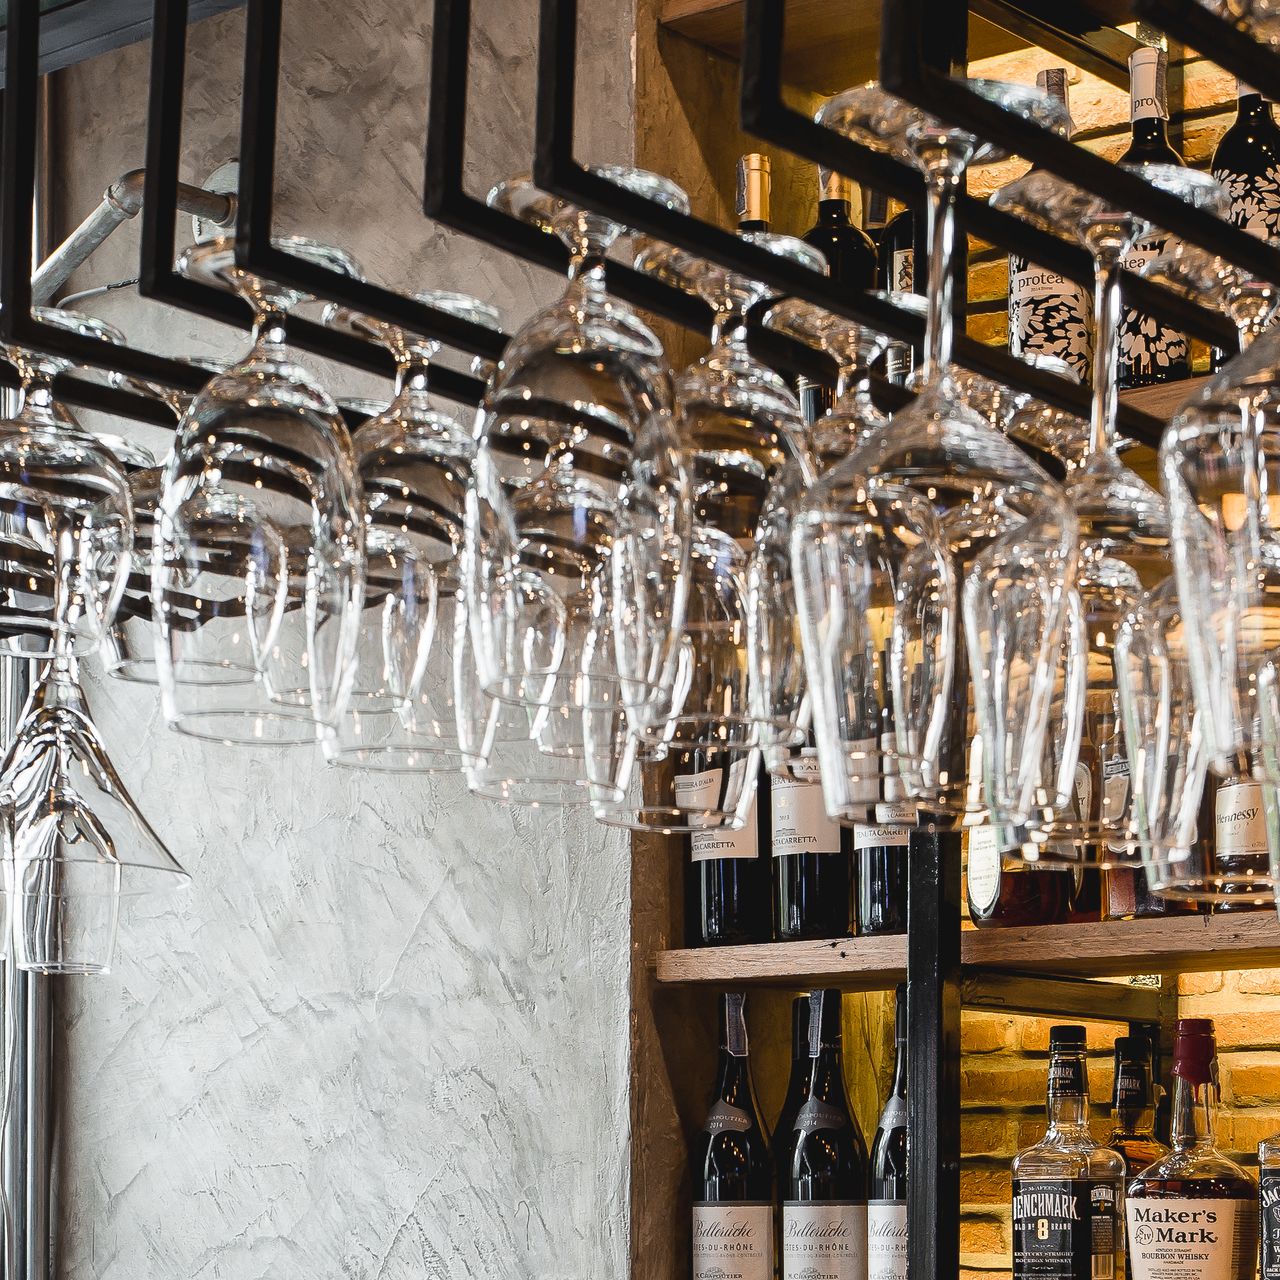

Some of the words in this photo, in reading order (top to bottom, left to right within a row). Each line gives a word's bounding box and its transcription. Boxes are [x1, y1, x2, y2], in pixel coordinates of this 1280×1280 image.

[1018, 272, 1065, 288] protea
[1134, 1207, 1218, 1224] Maker's
[1155, 1227, 1219, 1244] Mark
[1141, 1252, 1176, 1260] BOURBON
